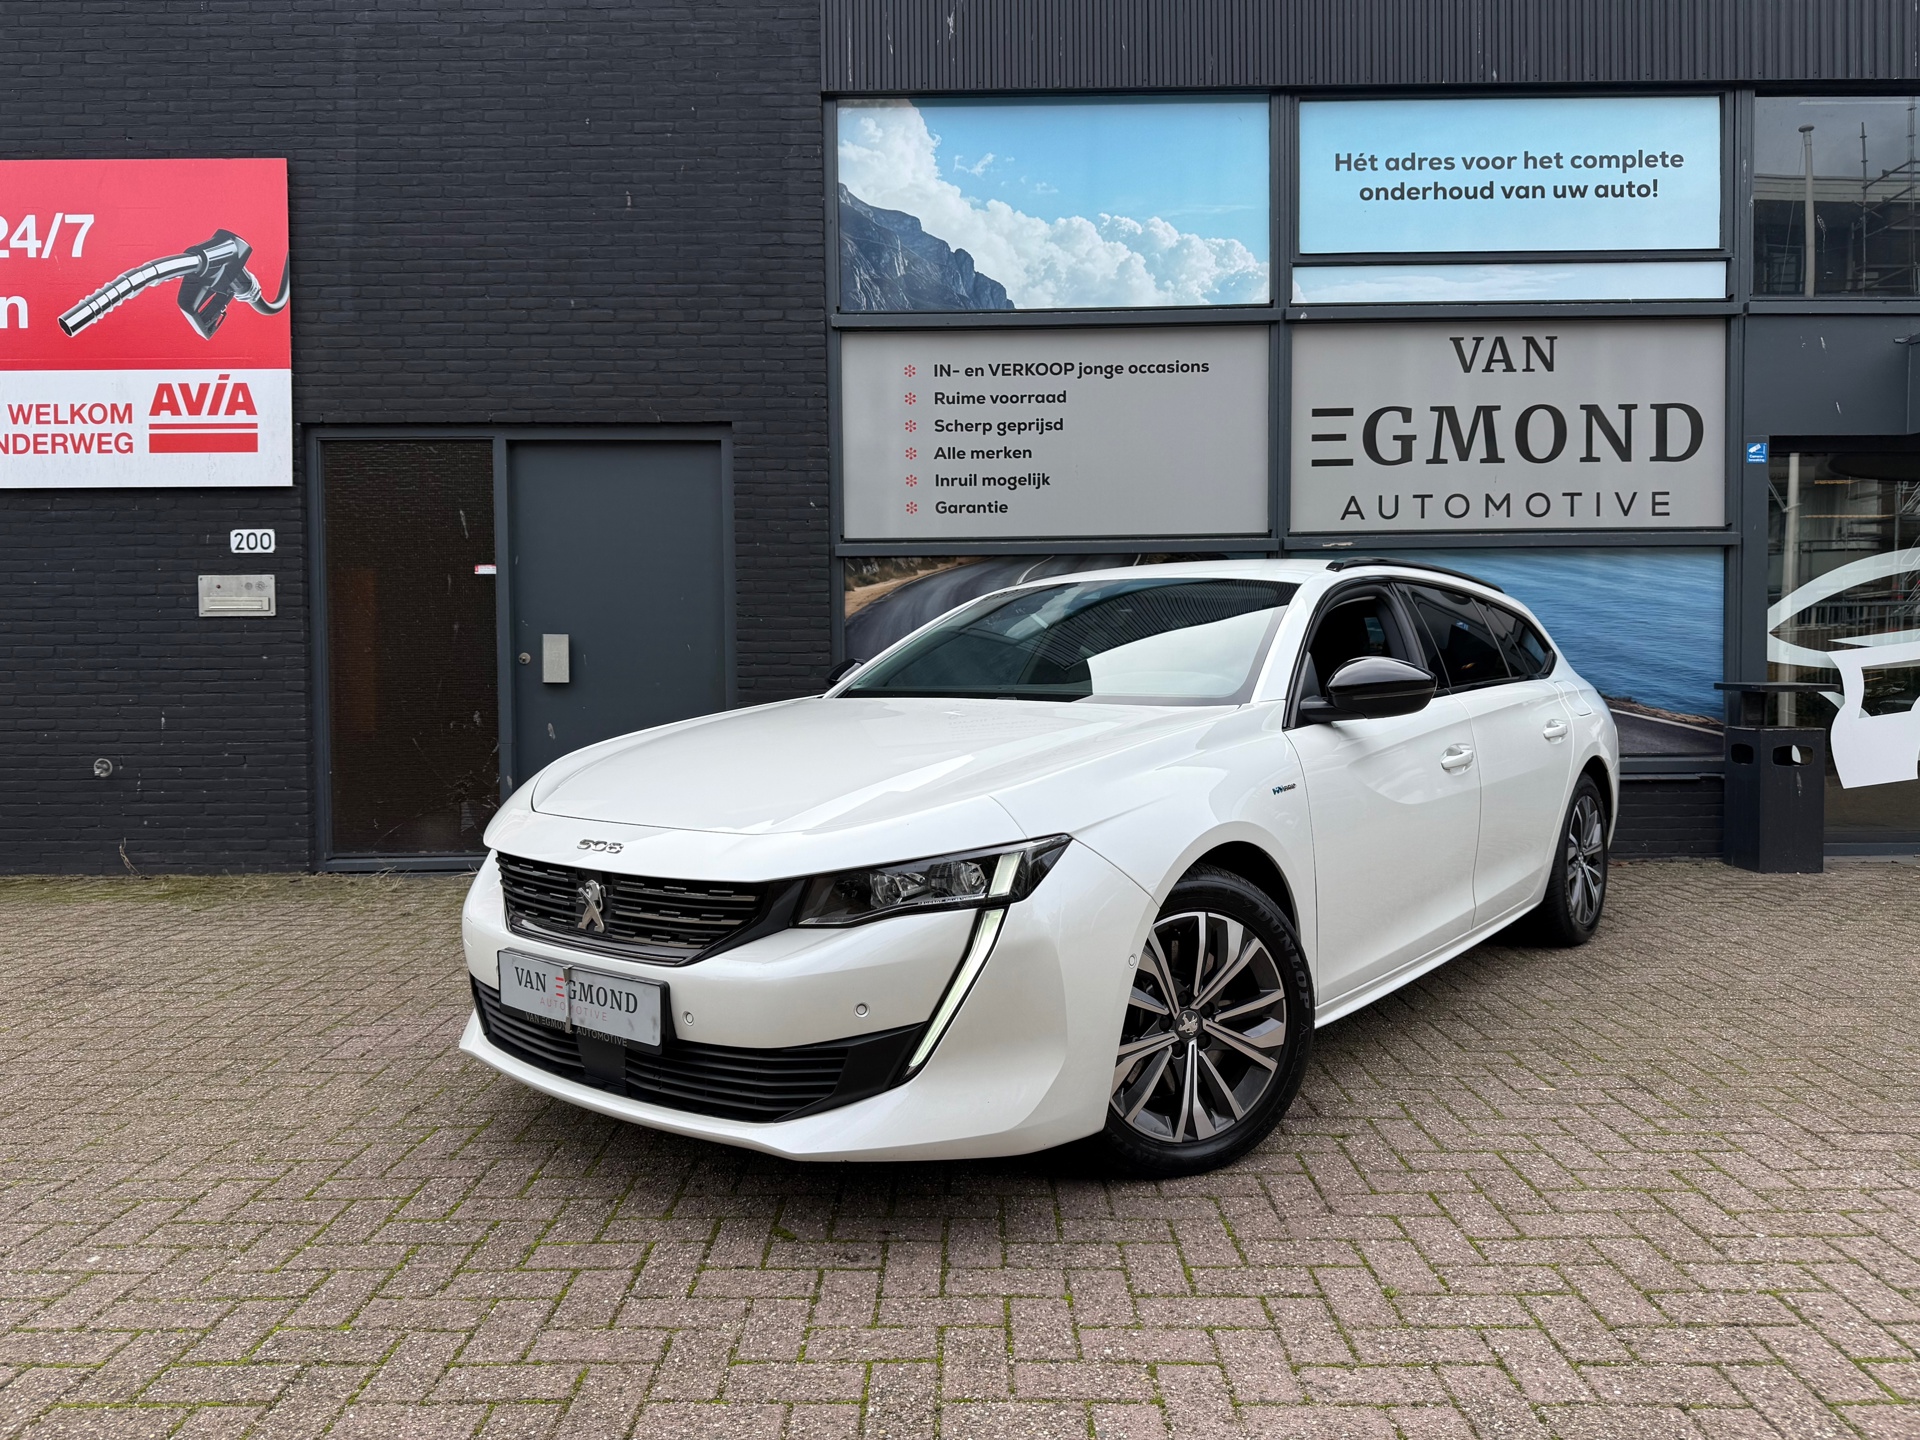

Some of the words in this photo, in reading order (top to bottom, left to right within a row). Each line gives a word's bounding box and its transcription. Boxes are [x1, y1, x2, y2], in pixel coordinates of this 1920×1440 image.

[1334, 152, 1379, 172] Hét
[1384, 152, 1456, 171] adres
[1461, 155, 1518, 170] voor
[1523, 151, 1564, 169] het
[1570, 149, 1685, 174] complete
[1359, 180, 1495, 201] onderhoud
[1500, 185, 1546, 200] van
[1552, 184, 1589, 199] uw
[1594, 178, 1659, 199] auto!
[1449, 335, 1558, 373] VAN
[933, 363, 961, 378] IN-
[964, 366, 985, 377] en
[988, 362, 1075, 377] VERKOOP
[1077, 361, 1124, 380] jonge
[1128, 360, 1210, 375] occasions
[934, 391, 986, 405] Ruime
[989, 390, 1067, 405] voorraad
[7, 403, 134, 425] WELKOM
[934, 418, 993, 436] Scherp
[996, 417, 1064, 436] geprijsd
[1311, 402, 1704, 467] EGMOND
[933, 446, 966, 460] Alle
[970, 446, 1032, 460] merken
[935, 473, 977, 488] Inruil
[982, 472, 1051, 491] mogelijk
[935, 500, 1009, 514] Garantie
[1340, 491, 1671, 520] AUTOMOTIVE
[234, 532, 272, 551] 200
[577, 839, 624, 854] 508
[1255, 907, 1310, 1009] DUNLOP
[514, 966, 547, 993] VAN
[555, 976, 638, 1014] EGMOND
[540, 997, 608, 1022] AUTOOTIVE
[525, 1011, 540, 1024] VAN
[541, 1017, 567, 1031] EGMON
[576, 1026, 628, 1047] AUTOMOTIVE
